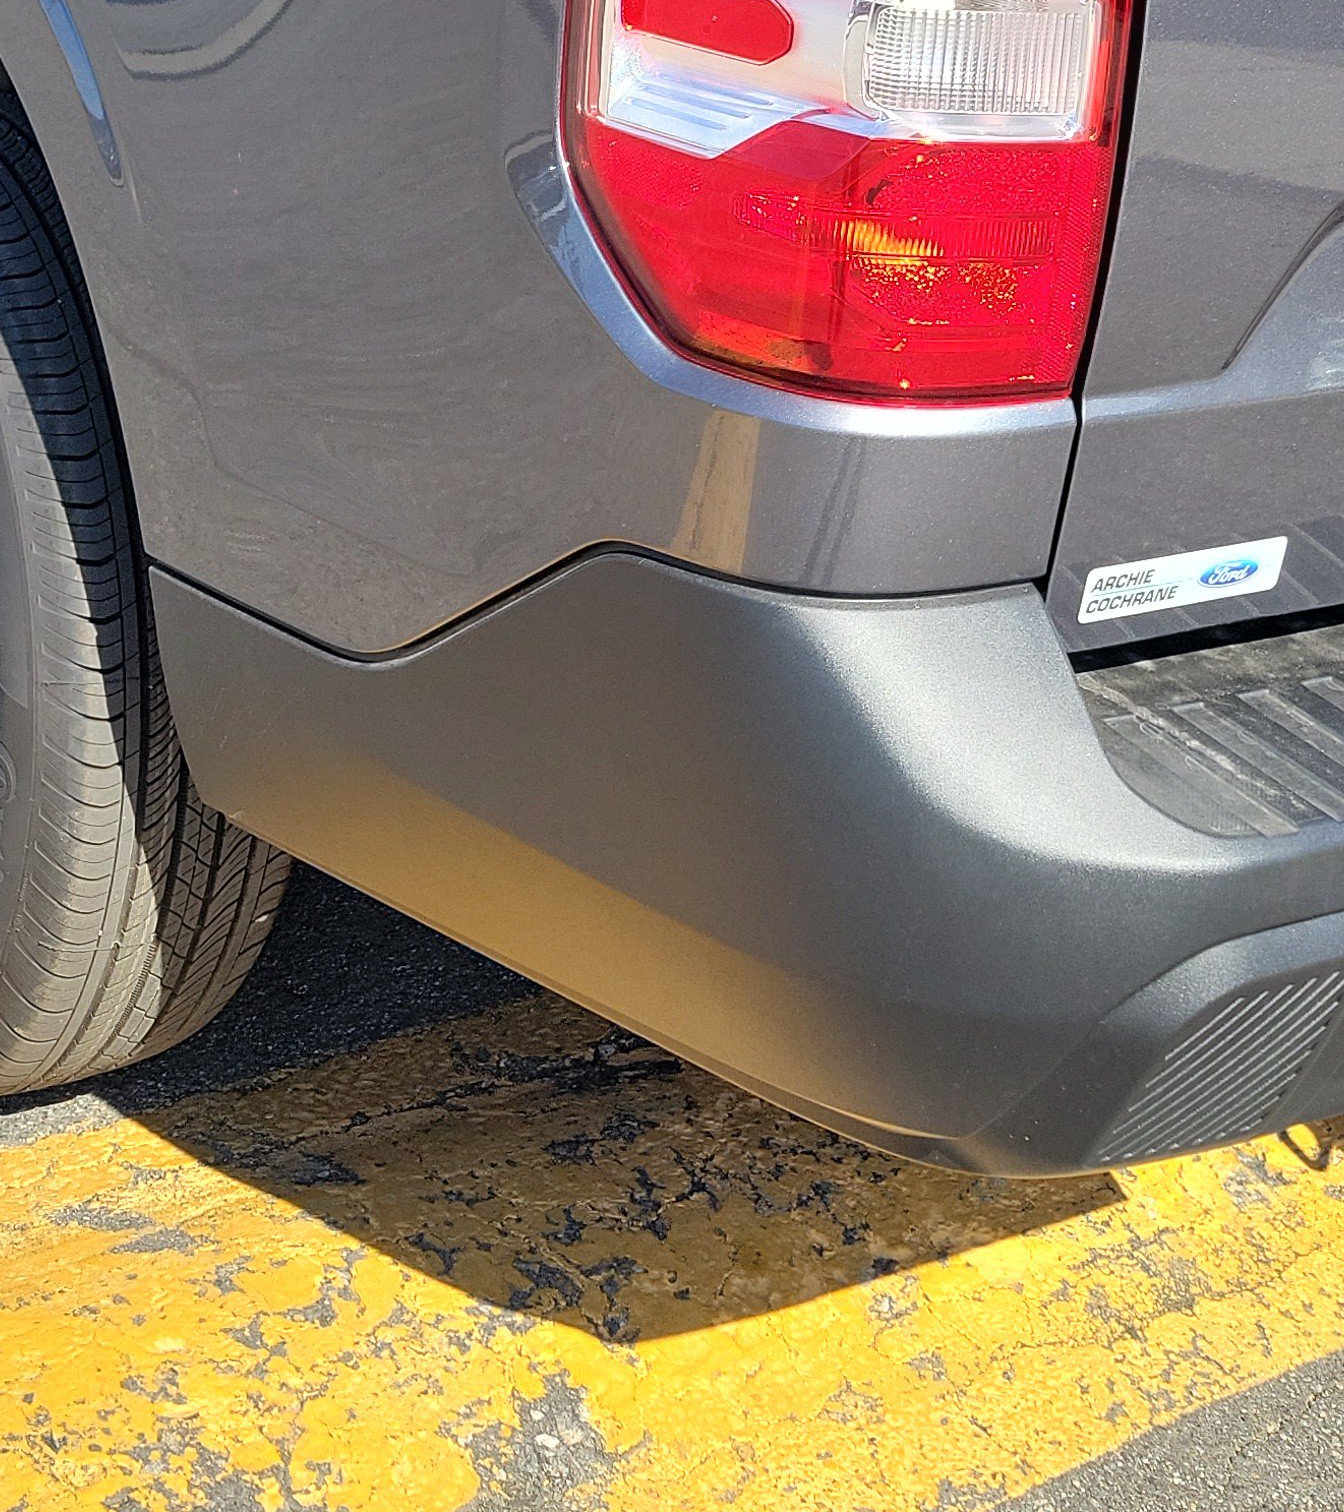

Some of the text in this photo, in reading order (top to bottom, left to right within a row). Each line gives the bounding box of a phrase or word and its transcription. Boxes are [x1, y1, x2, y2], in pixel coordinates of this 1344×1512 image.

[1090, 569, 1156, 593] ARCHIE
[1207, 561, 1252, 584] Ford
[1085, 585, 1179, 614] COCHRANE
